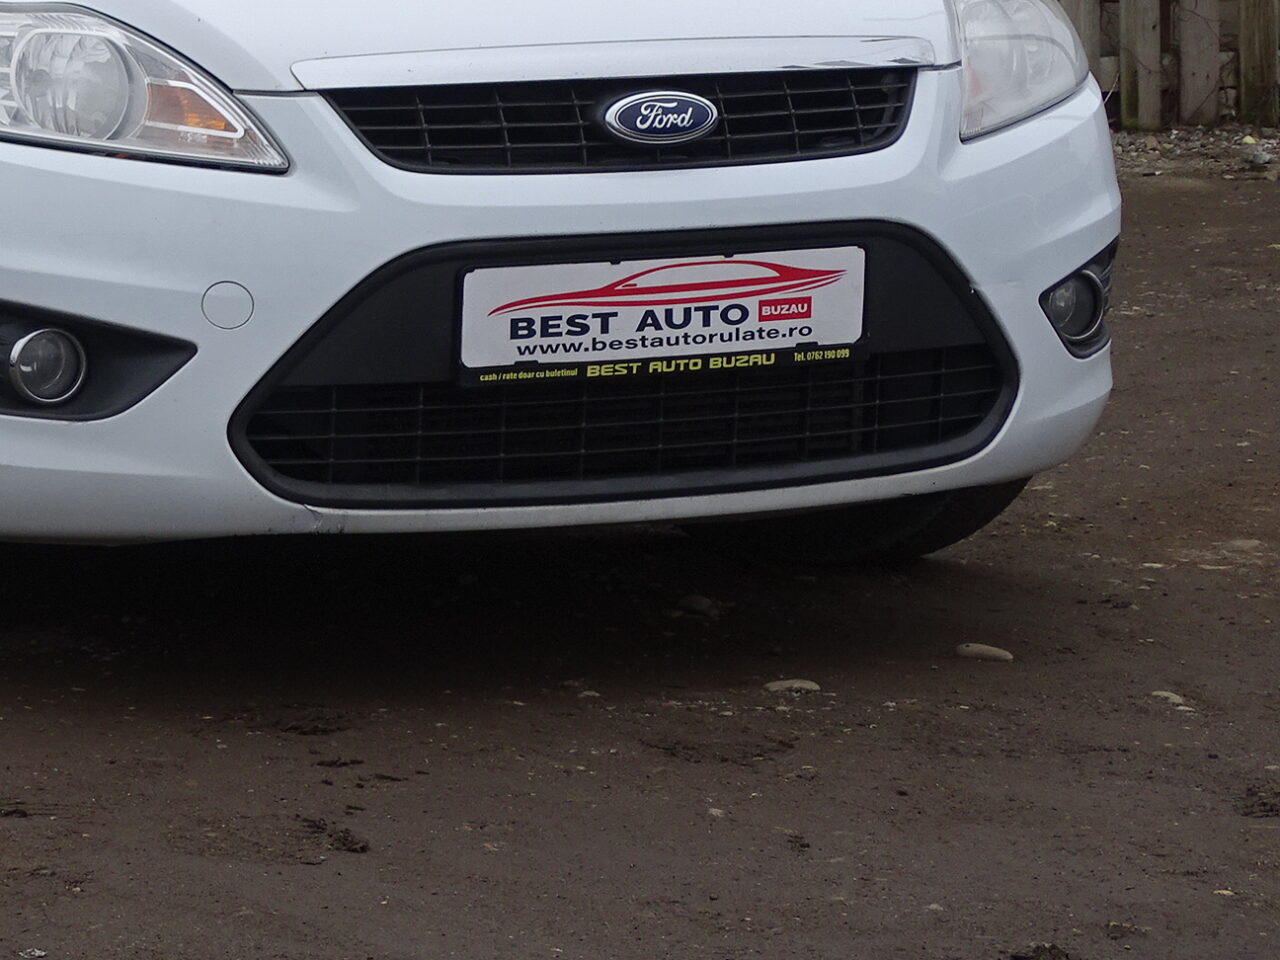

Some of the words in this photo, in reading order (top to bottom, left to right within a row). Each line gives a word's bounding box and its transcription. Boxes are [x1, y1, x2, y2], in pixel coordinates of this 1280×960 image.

[635, 101, 694, 130] Ford
[509, 311, 619, 340] BEST
[635, 303, 750, 333] AUTO
[761, 302, 809, 316] BUZAU
[516, 324, 813, 356] www.bestautorulate.ro
[586, 362, 642, 377] BEST
[648, 358, 703, 374] AUTO
[708, 353, 776, 370] BUZAU
